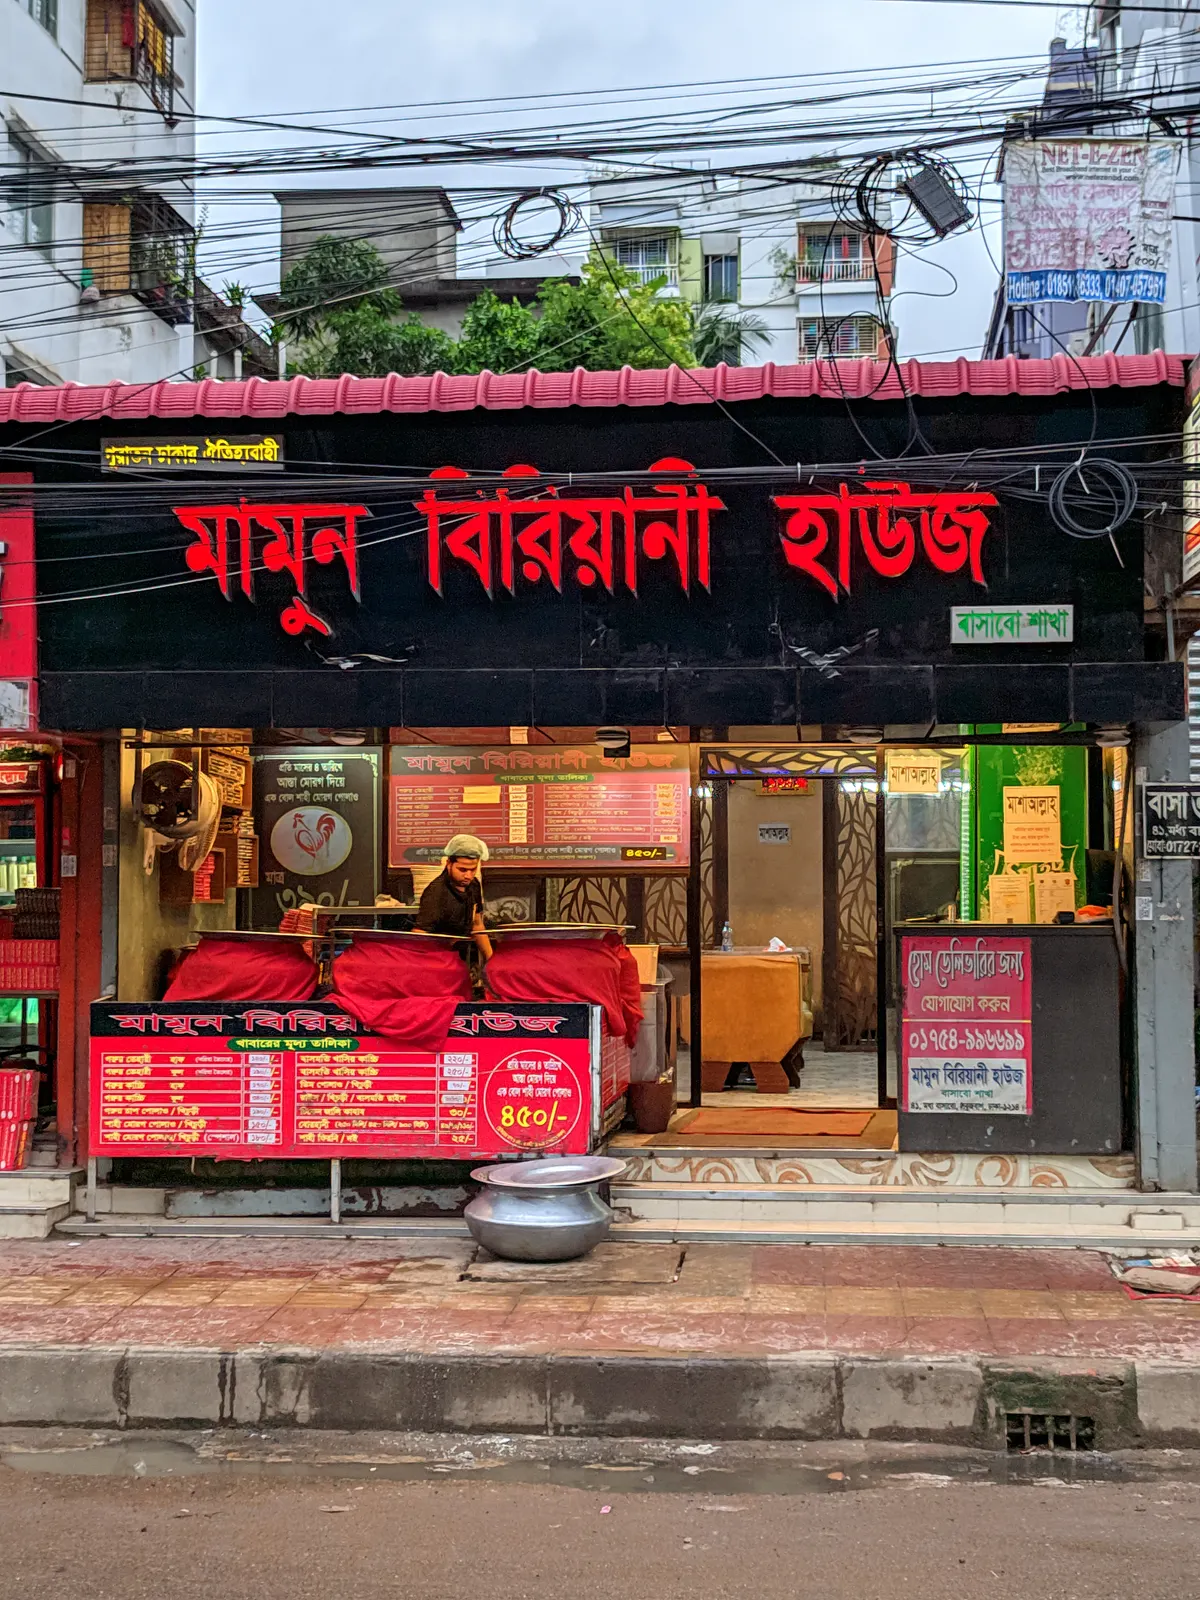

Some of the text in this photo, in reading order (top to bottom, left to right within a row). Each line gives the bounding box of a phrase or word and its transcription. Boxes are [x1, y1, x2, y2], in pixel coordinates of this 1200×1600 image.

[172, 457, 1000, 638] মামুন বিরিয়ানী হাউজ
[957, 610, 1070, 637] বাসাবো শাখা
[401, 754, 477, 774] মামুন
[478, 750, 592, 771] বিরিয়ানী
[300, 777, 324, 789] মোরগ
[1147, 791, 1189, 820] বাসা
[908, 950, 933, 987] হোম
[997, 950, 1024, 981] জন্য
[921, 995, 1011, 1013] যোগাযোগ করুন
[108, 1013, 234, 1035] মামুন
[235, 1038, 352, 1051] খাবারের মূল্য তালিকা
[909, 1028, 1025, 1051] ০১৭৫৪-৯৯৬৬৯৯
[911, 1061, 1025, 1088] মামুন বিরিয়ানী হাউজ
[941, 1089, 994, 1098] বাসাবো শাখা
[501, 1100, 568, 1132] ৪৫০/-
